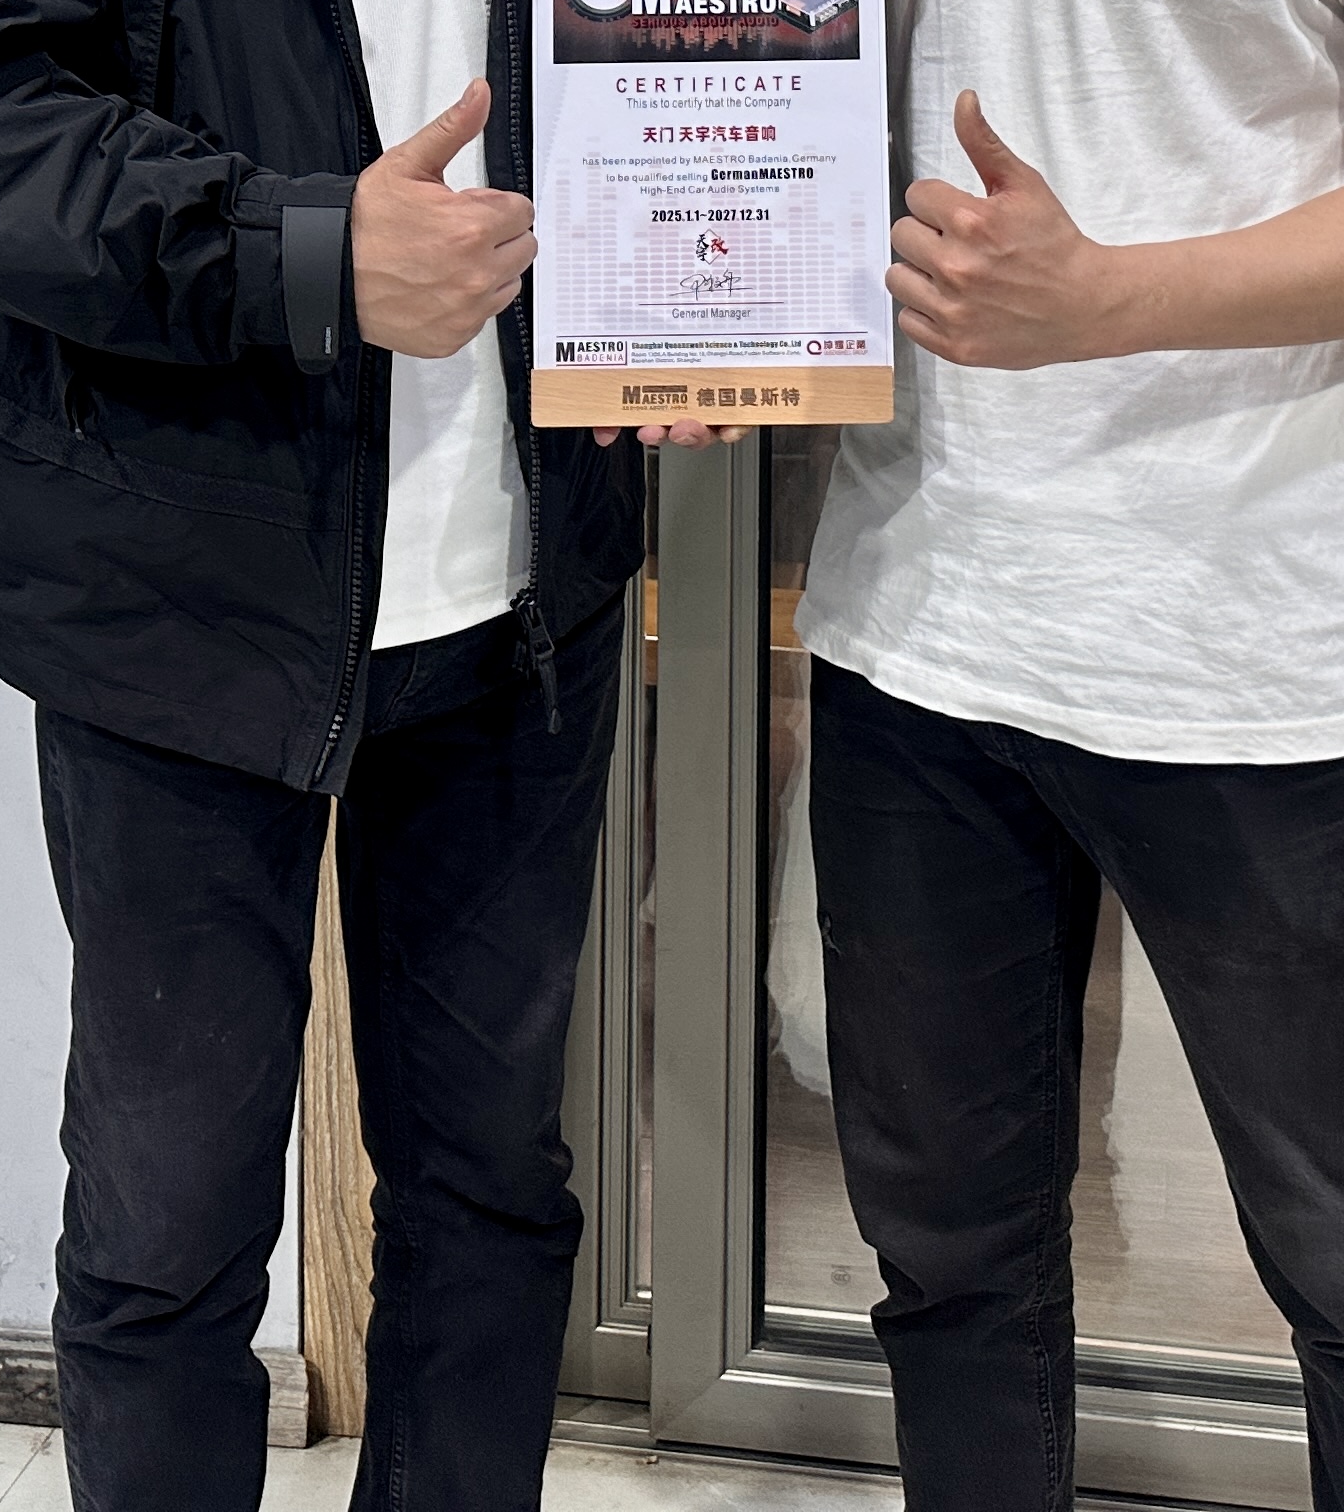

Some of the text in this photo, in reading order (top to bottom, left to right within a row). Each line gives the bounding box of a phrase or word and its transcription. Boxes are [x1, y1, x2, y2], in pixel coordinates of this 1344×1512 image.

[631, 16, 780, 29] SERIOUS ABOUT AUDIO
[615, 75, 802, 94] CERTIFICATE
[626, 96, 792, 111] This is to certify that the Company
[643, 125, 776, 143] 天门 天宇汽车音响
[582, 157, 600, 166] has
[602, 157, 626, 166] been
[628, 156, 677, 167] appointed
[679, 156, 691, 166] by
[693, 155, 746, 164] MAESTRO
[606, 167, 814, 183] to be qualified selling GermanMAESTRO
[640, 184, 780, 196] High-End Car Audio Systems
[672, 307, 752, 320] General Manager
[556, 340, 624, 363] MAESTRO
[576, 353, 624, 362] BADENIA
[622, 385, 688, 405] MAESTRO
[696, 387, 801, 407] 德国曼斯特
